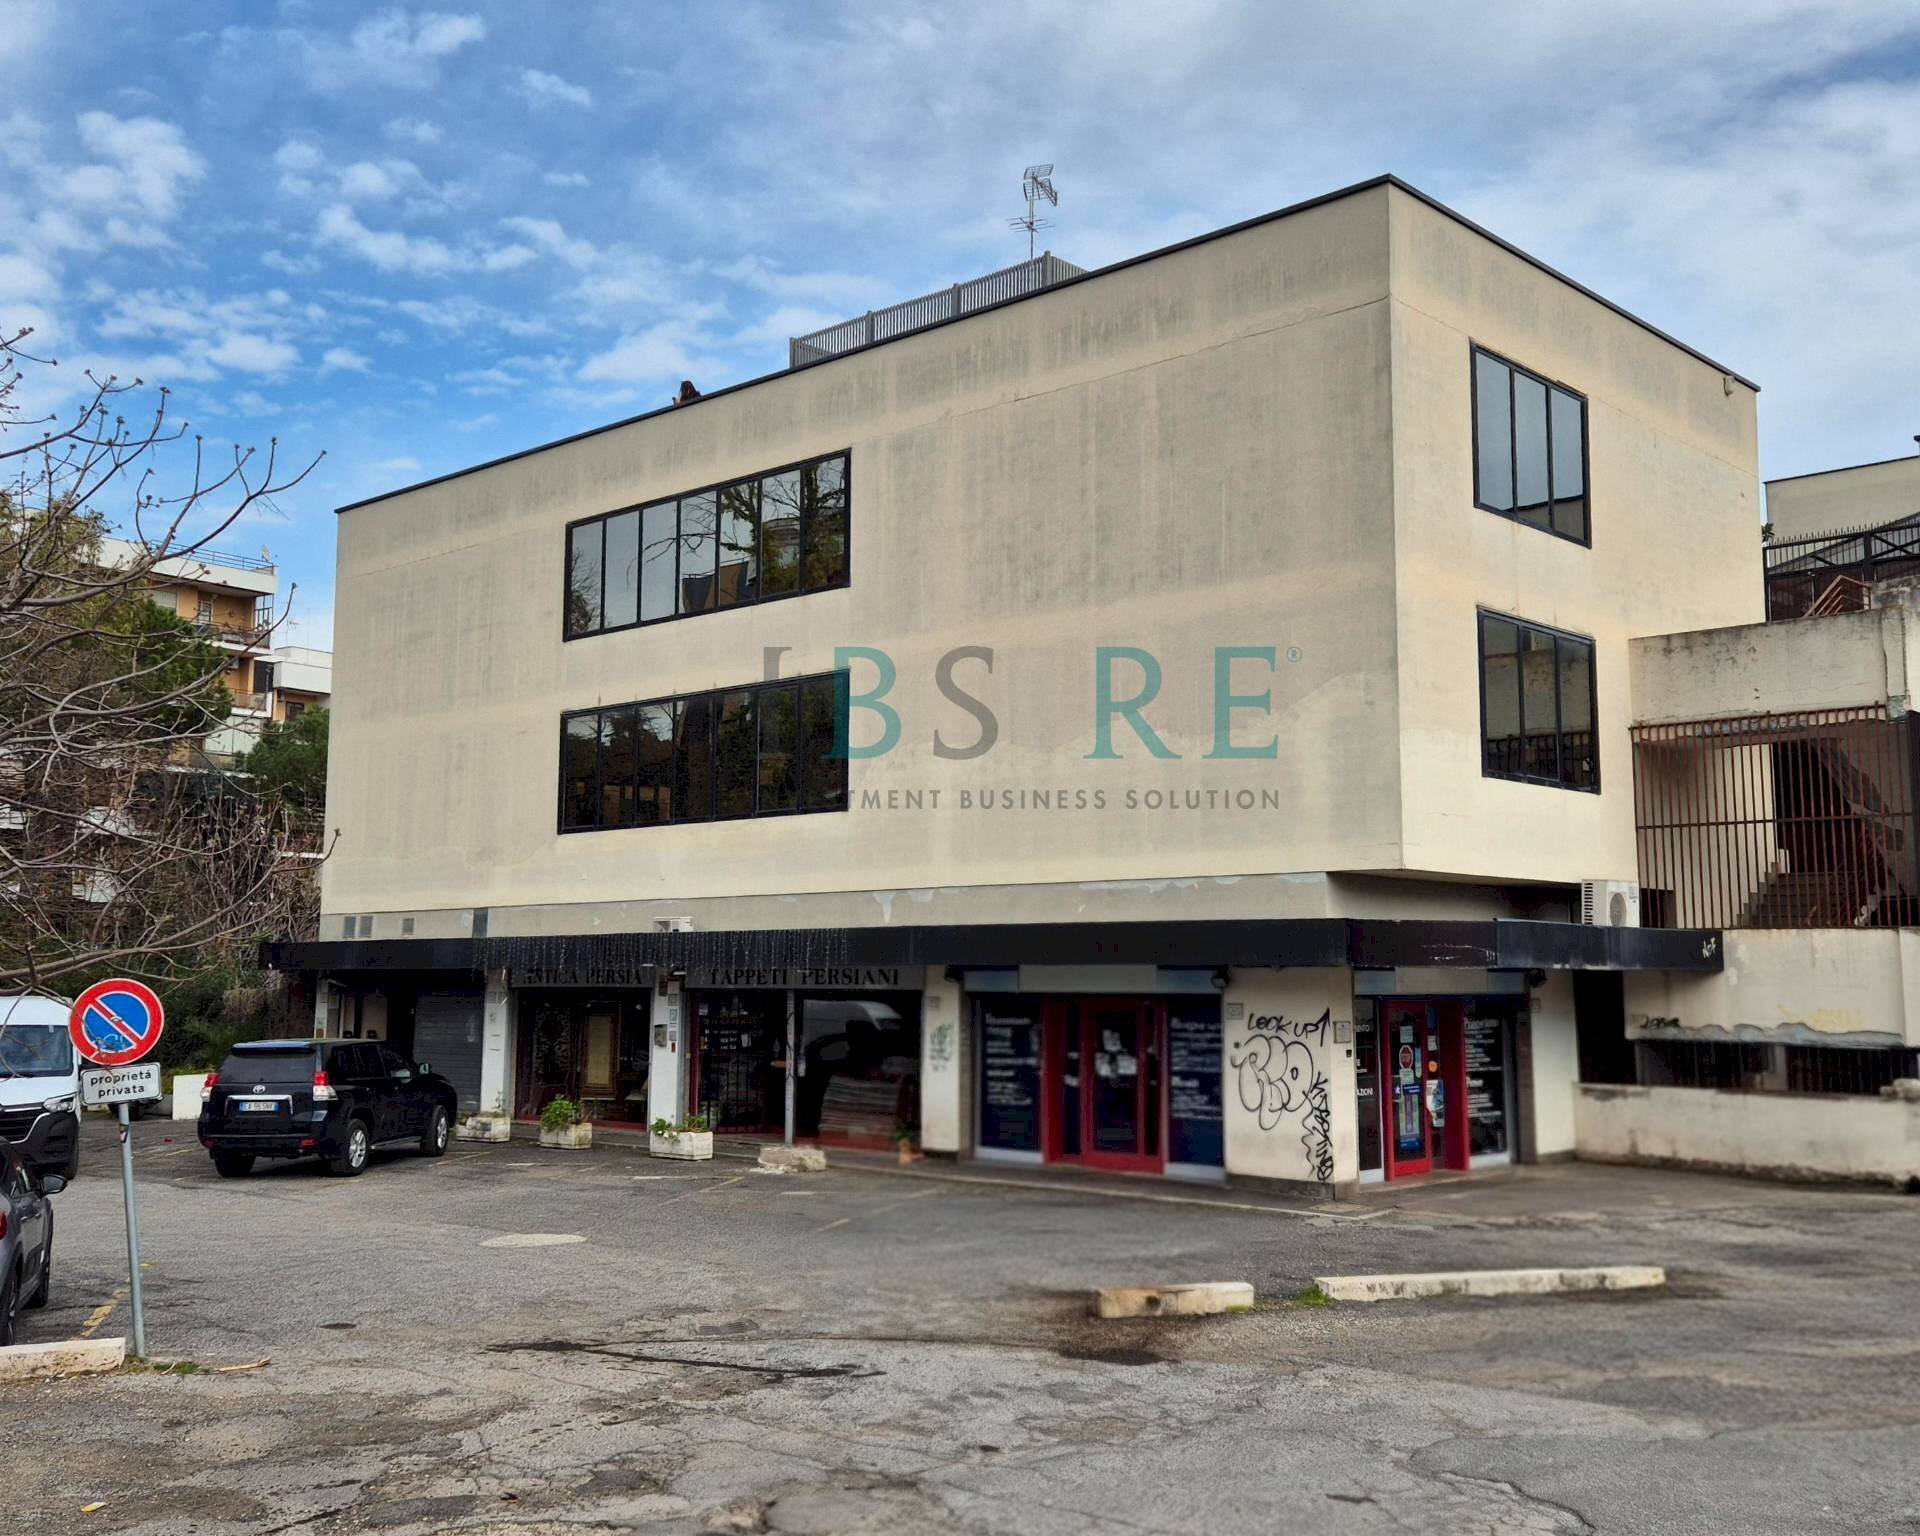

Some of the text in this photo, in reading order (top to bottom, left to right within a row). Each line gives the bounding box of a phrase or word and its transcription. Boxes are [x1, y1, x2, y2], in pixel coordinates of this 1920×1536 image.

[585, 968, 642, 985] PERSIA
[708, 968, 898, 985] TAPPETI PERSIANI
[1247, 1013, 1292, 1034] LOOK
[98, 1084, 145, 1098] privata
